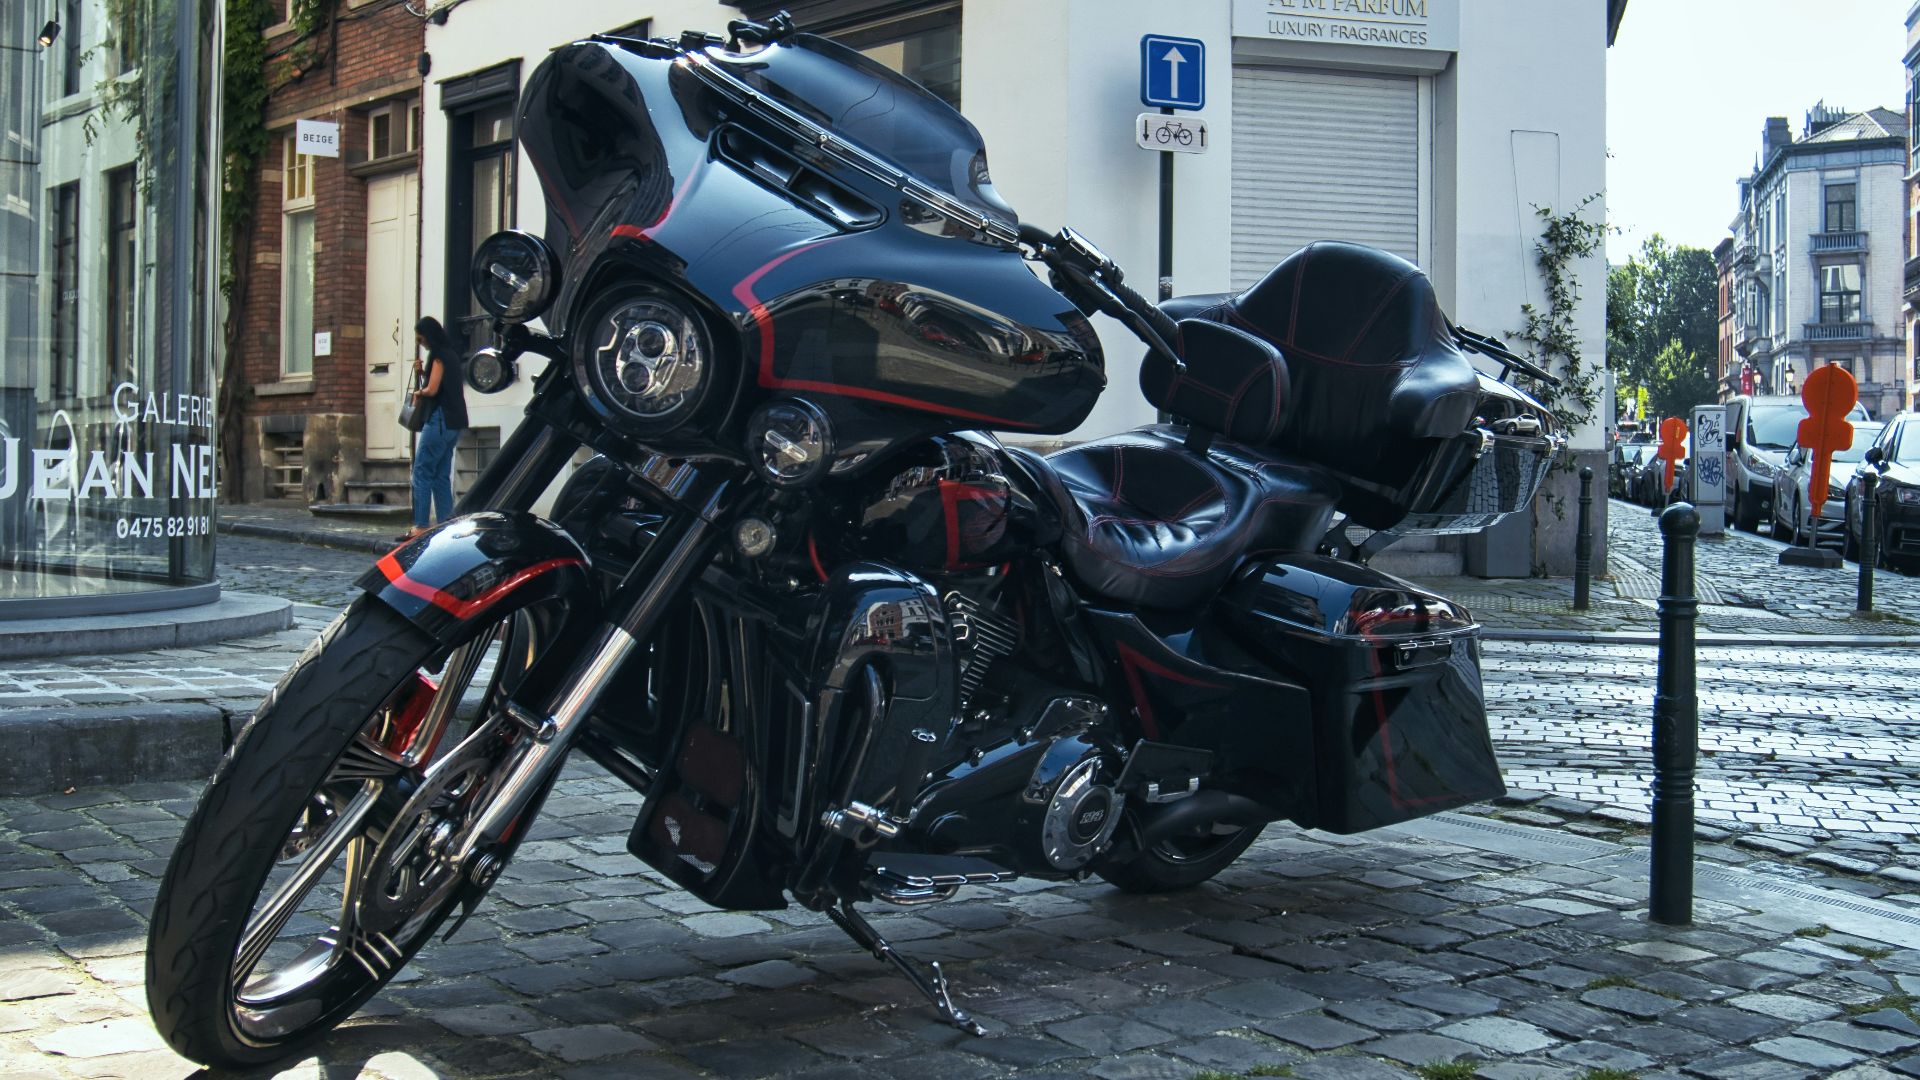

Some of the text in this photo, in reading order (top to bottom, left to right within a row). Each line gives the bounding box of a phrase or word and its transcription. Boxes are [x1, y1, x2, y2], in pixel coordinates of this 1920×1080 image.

[1268, 20, 1427, 45] LUXURY FRAGRANCES
[303, 133, 333, 144] BEIGE
[113, 382, 212, 428] GALERIE
[0, 438, 154, 499] JEAN
[116, 516, 209, 538] 0475 82 91 81
